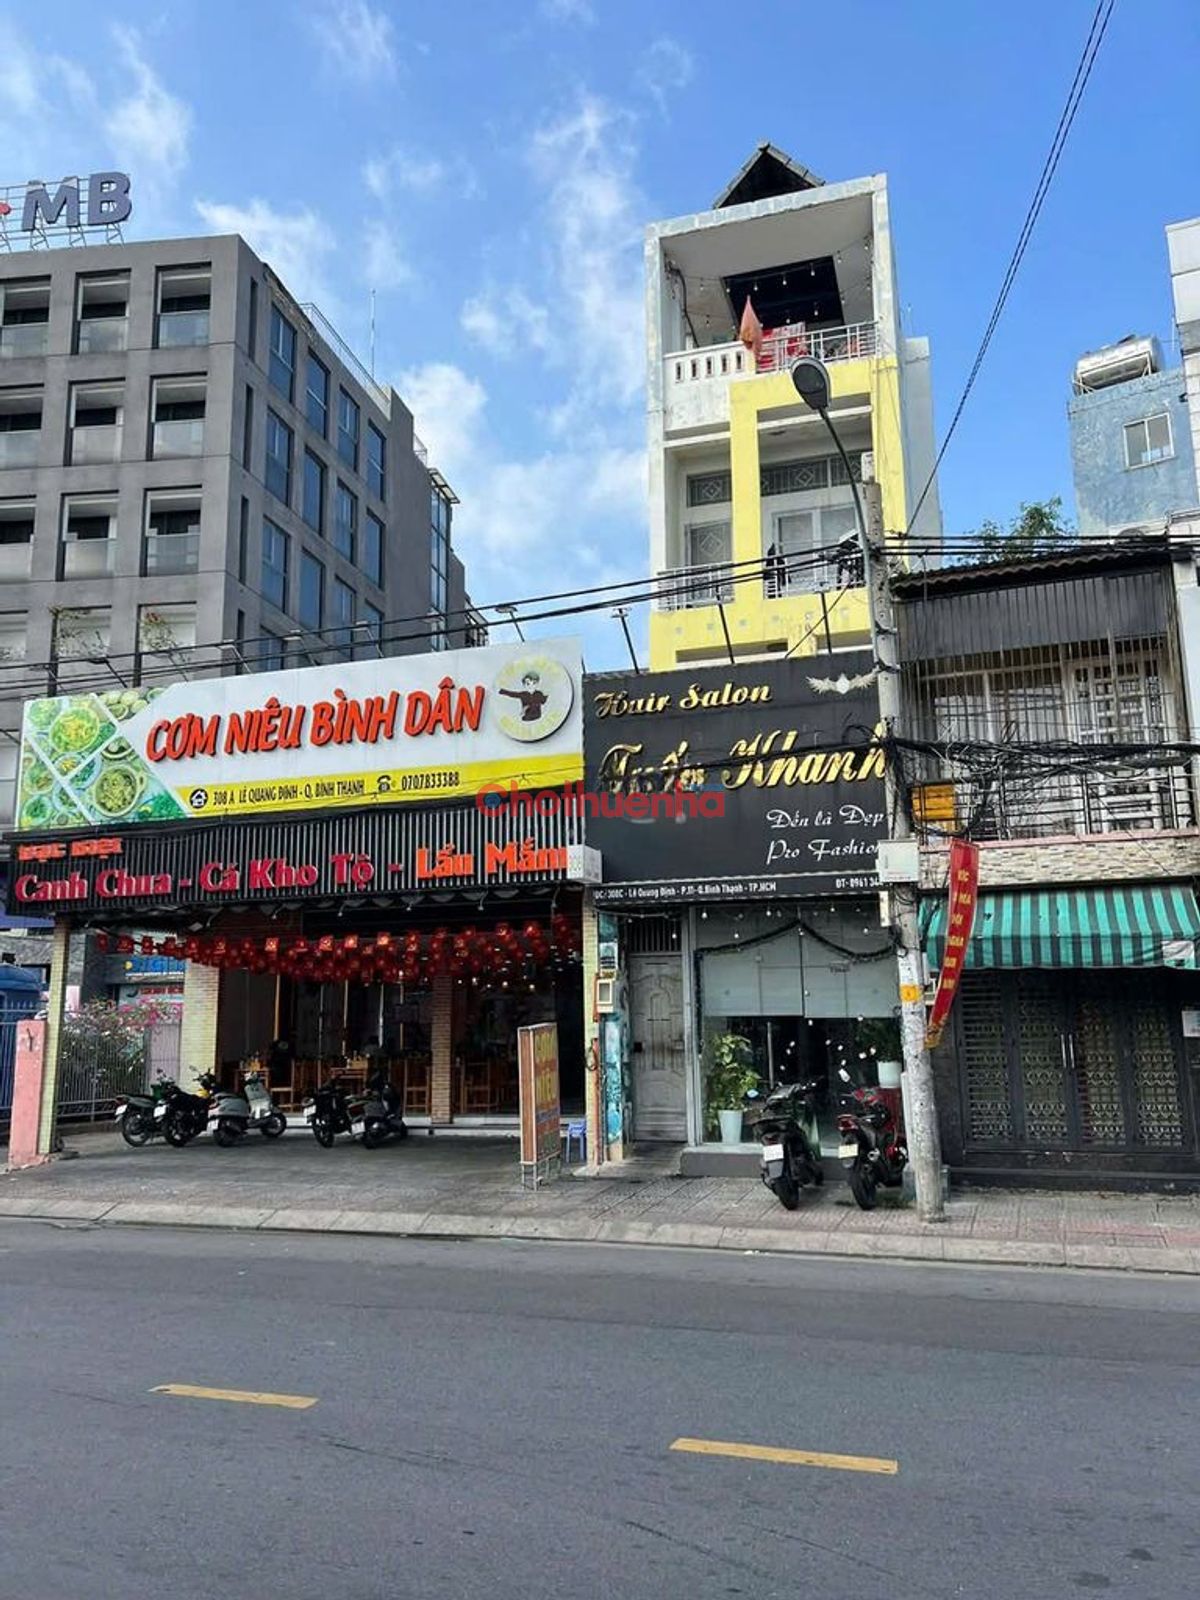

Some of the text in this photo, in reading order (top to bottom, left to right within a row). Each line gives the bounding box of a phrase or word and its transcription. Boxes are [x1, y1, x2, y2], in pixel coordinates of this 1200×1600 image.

[21, 172, 132, 232] MB
[594, 682, 772, 718] Hair Salon
[145, 676, 486, 763] CƠM NIÊU BÌNH DÂN
[401, 771, 460, 790] 0707833388
[248, 785, 277, 804] QUANG
[814, 811, 833, 827] là
[766, 838, 881, 865] Pro Fashio
[15, 871, 89, 901] Canh
[95, 866, 171, 898] Chua
[200, 860, 240, 890] Cá
[249, 856, 319, 889] Kho
[330, 853, 375, 889] Tộ
[638, 887, 660, 900] Quang
